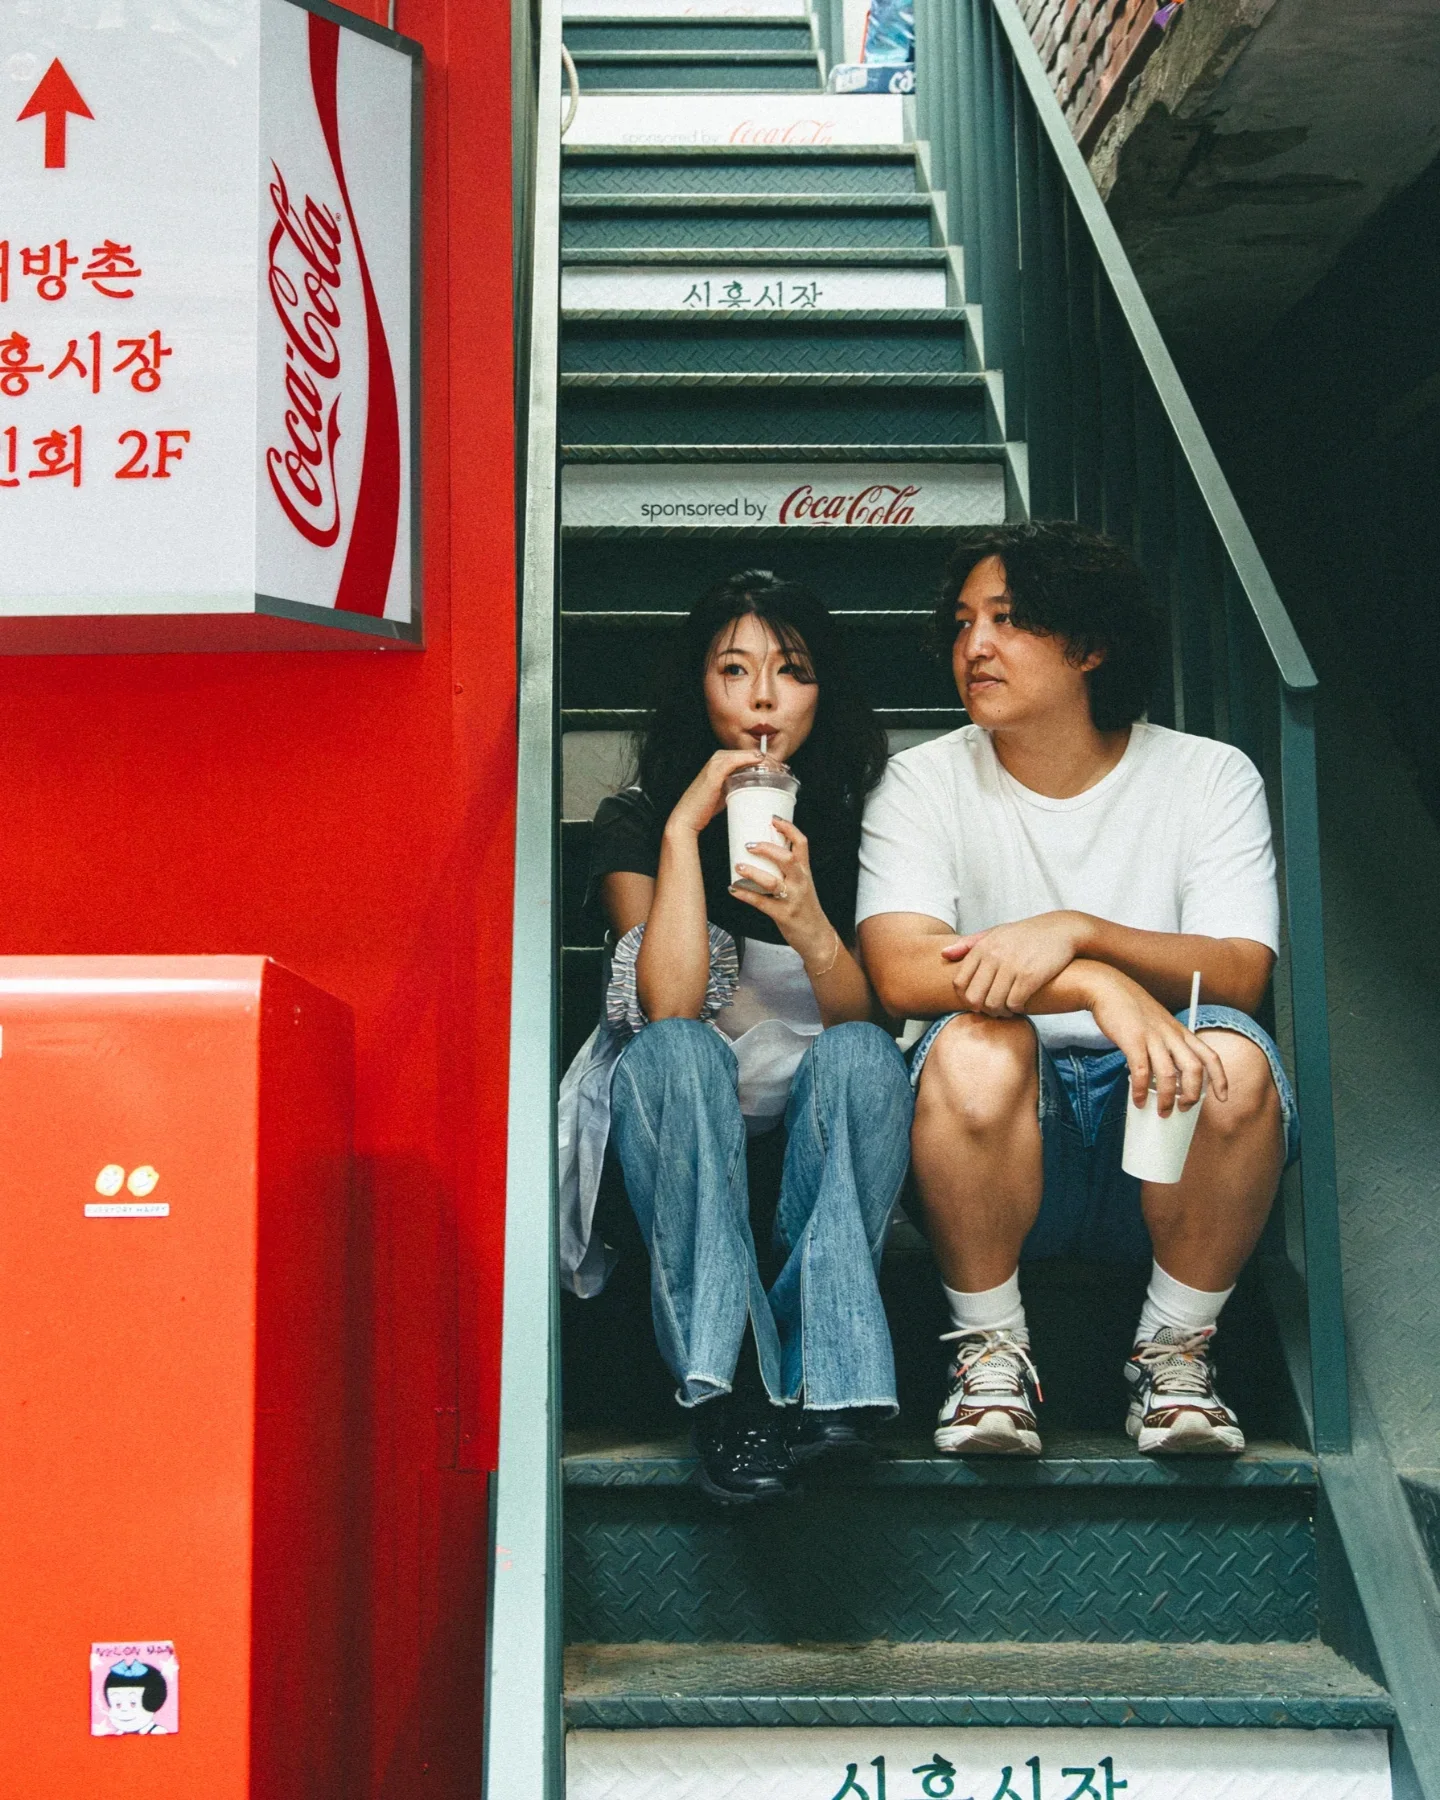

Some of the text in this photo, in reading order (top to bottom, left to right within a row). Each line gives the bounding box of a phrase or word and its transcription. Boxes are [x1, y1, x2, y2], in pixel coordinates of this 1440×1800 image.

[267, 156, 342, 547] Coca-Cola
[115, 429, 190, 479] 2F
[641, 484, 923, 524] sponsored by Coca-Cola
